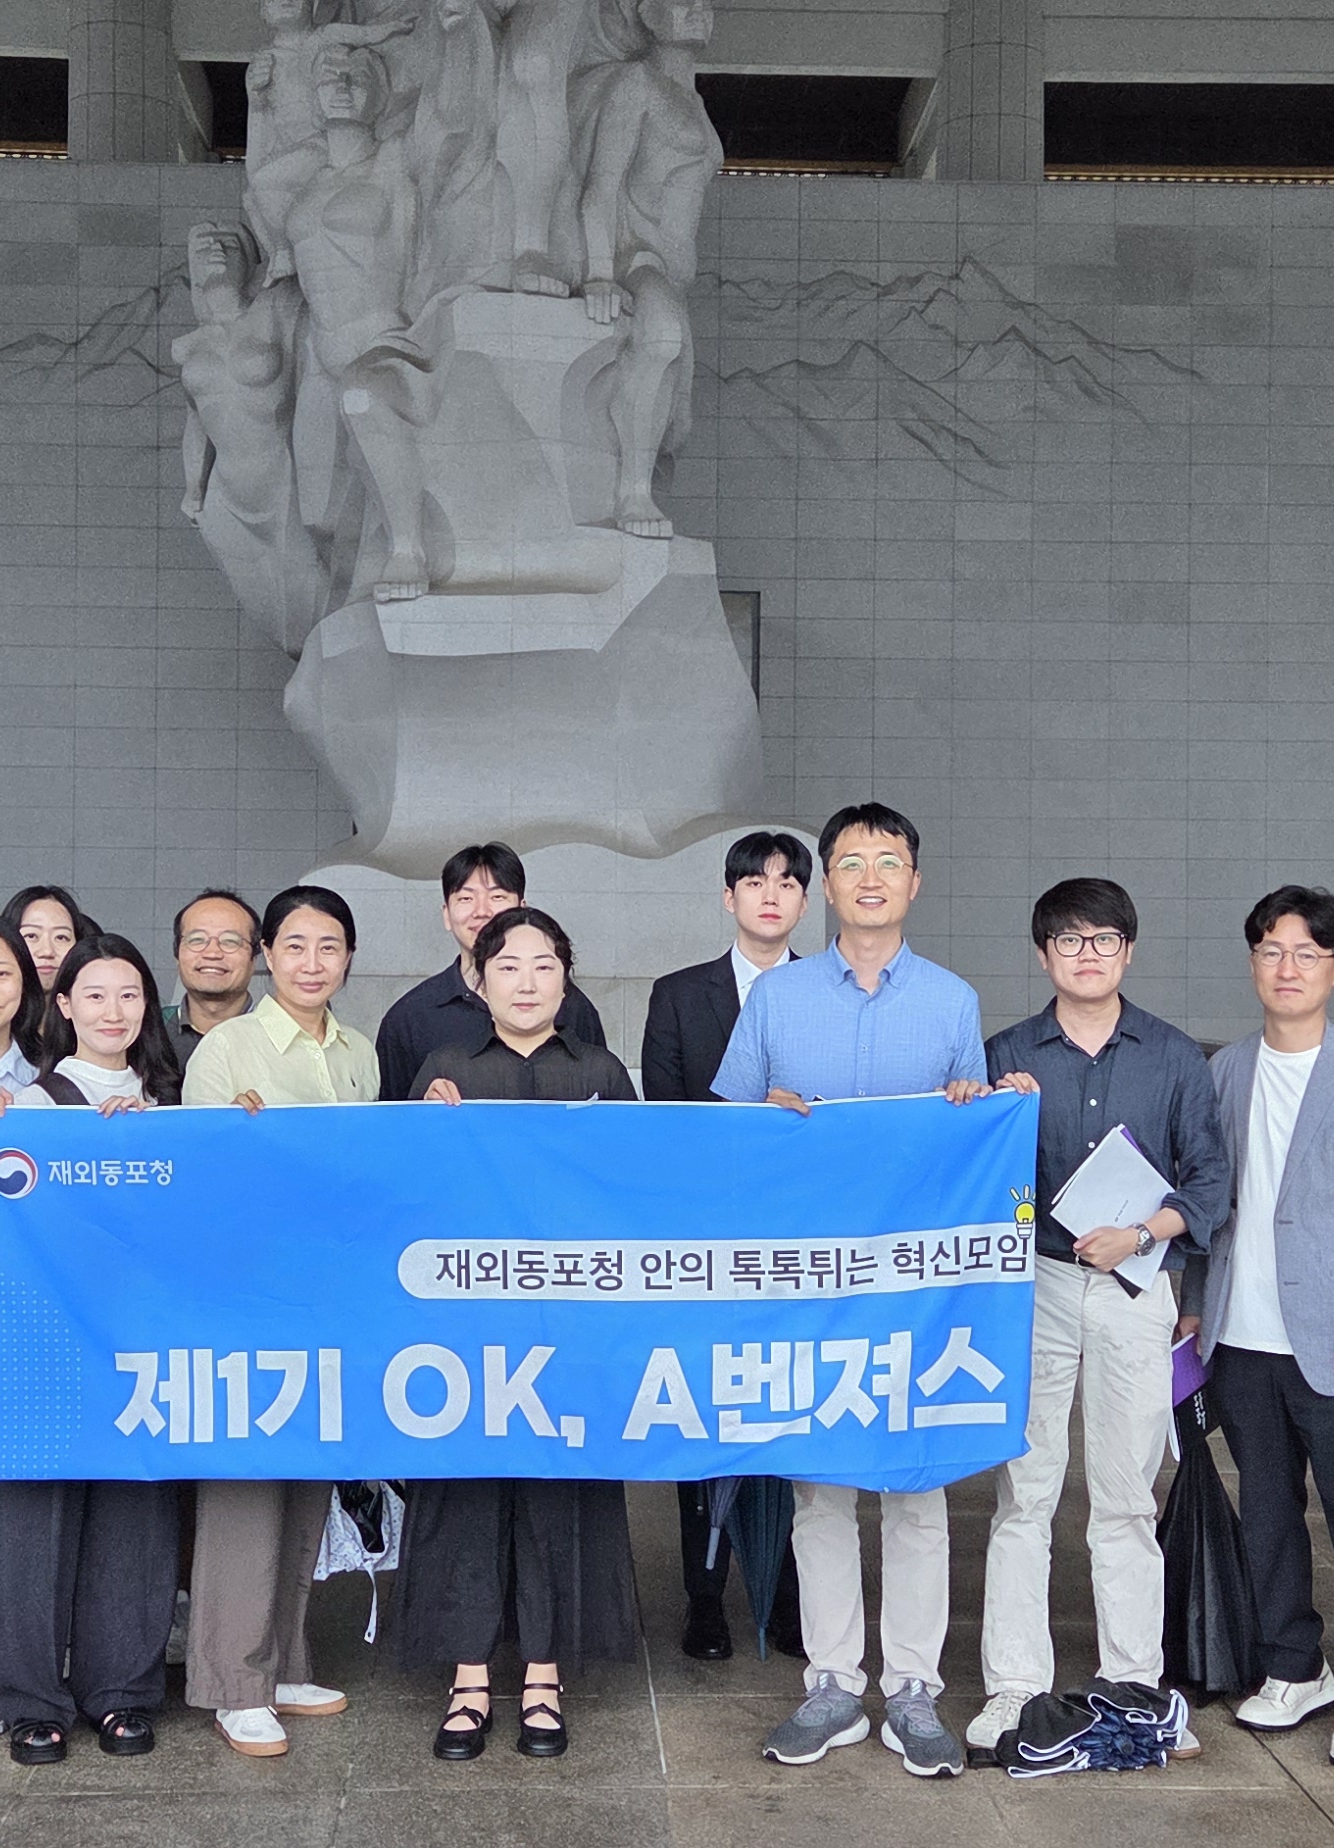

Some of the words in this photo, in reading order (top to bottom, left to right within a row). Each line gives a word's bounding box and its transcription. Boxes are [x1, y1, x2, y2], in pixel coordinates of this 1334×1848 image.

[47, 1159, 174, 1187] 재외동포청
[435, 1249, 623, 1291] 재외동포청
[640, 1249, 714, 1291] 안의
[729, 1247, 879, 1291] 톡톡튀는
[891, 1234, 1028, 1281] 혁신모임
[113, 1348, 343, 1444] 제1기
[382, 1343, 586, 1448] OK,
[621, 1326, 1007, 1443] A벤져스
